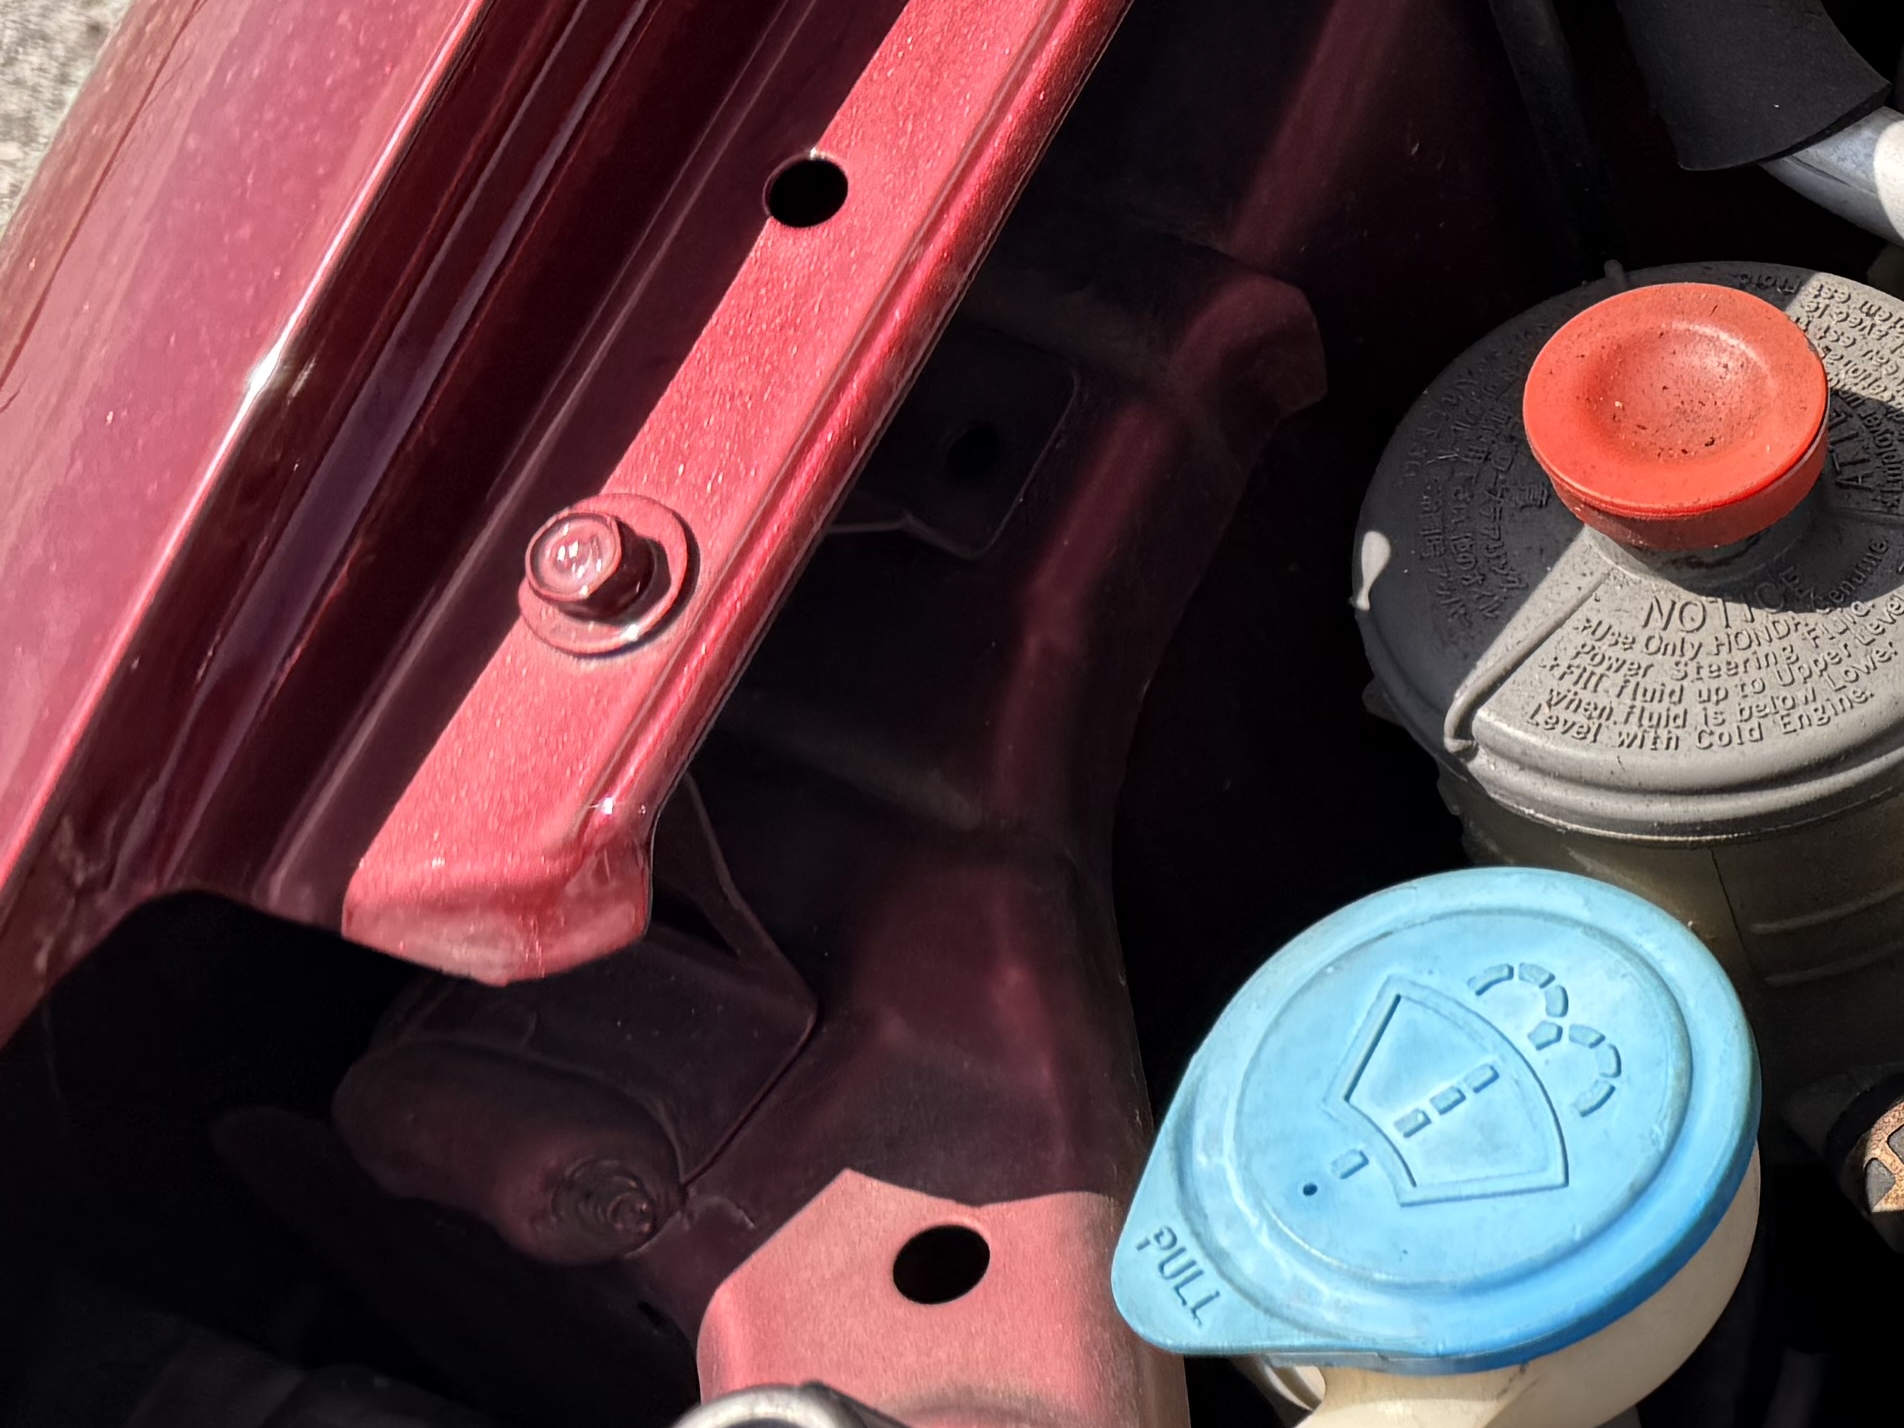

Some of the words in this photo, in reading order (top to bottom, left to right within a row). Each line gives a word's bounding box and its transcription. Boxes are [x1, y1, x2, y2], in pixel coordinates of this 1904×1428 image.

[1641, 568, 1812, 635] NOTICE
[1573, 643, 1655, 680] Power
[1669, 644, 1798, 682] Steering
[1617, 677, 1684, 705] fluid
[1697, 684, 1729, 708] up
[1739, 677, 1767, 700] to
[1775, 639, 1854, 691] Upper
[1643, 633, 1703, 662] Only
[1547, 687, 1613, 723] when
[1621, 704, 1688, 731] fluid
[1702, 705, 1726, 728] is
[1737, 686, 1820, 723] below
[1826, 639, 1898, 694] Lower
[1525, 704, 1604, 745] Level
[1617, 726, 1680, 752] with
[1694, 722, 1765, 752] Cold
[1133, 1222, 1223, 1329] PULL
